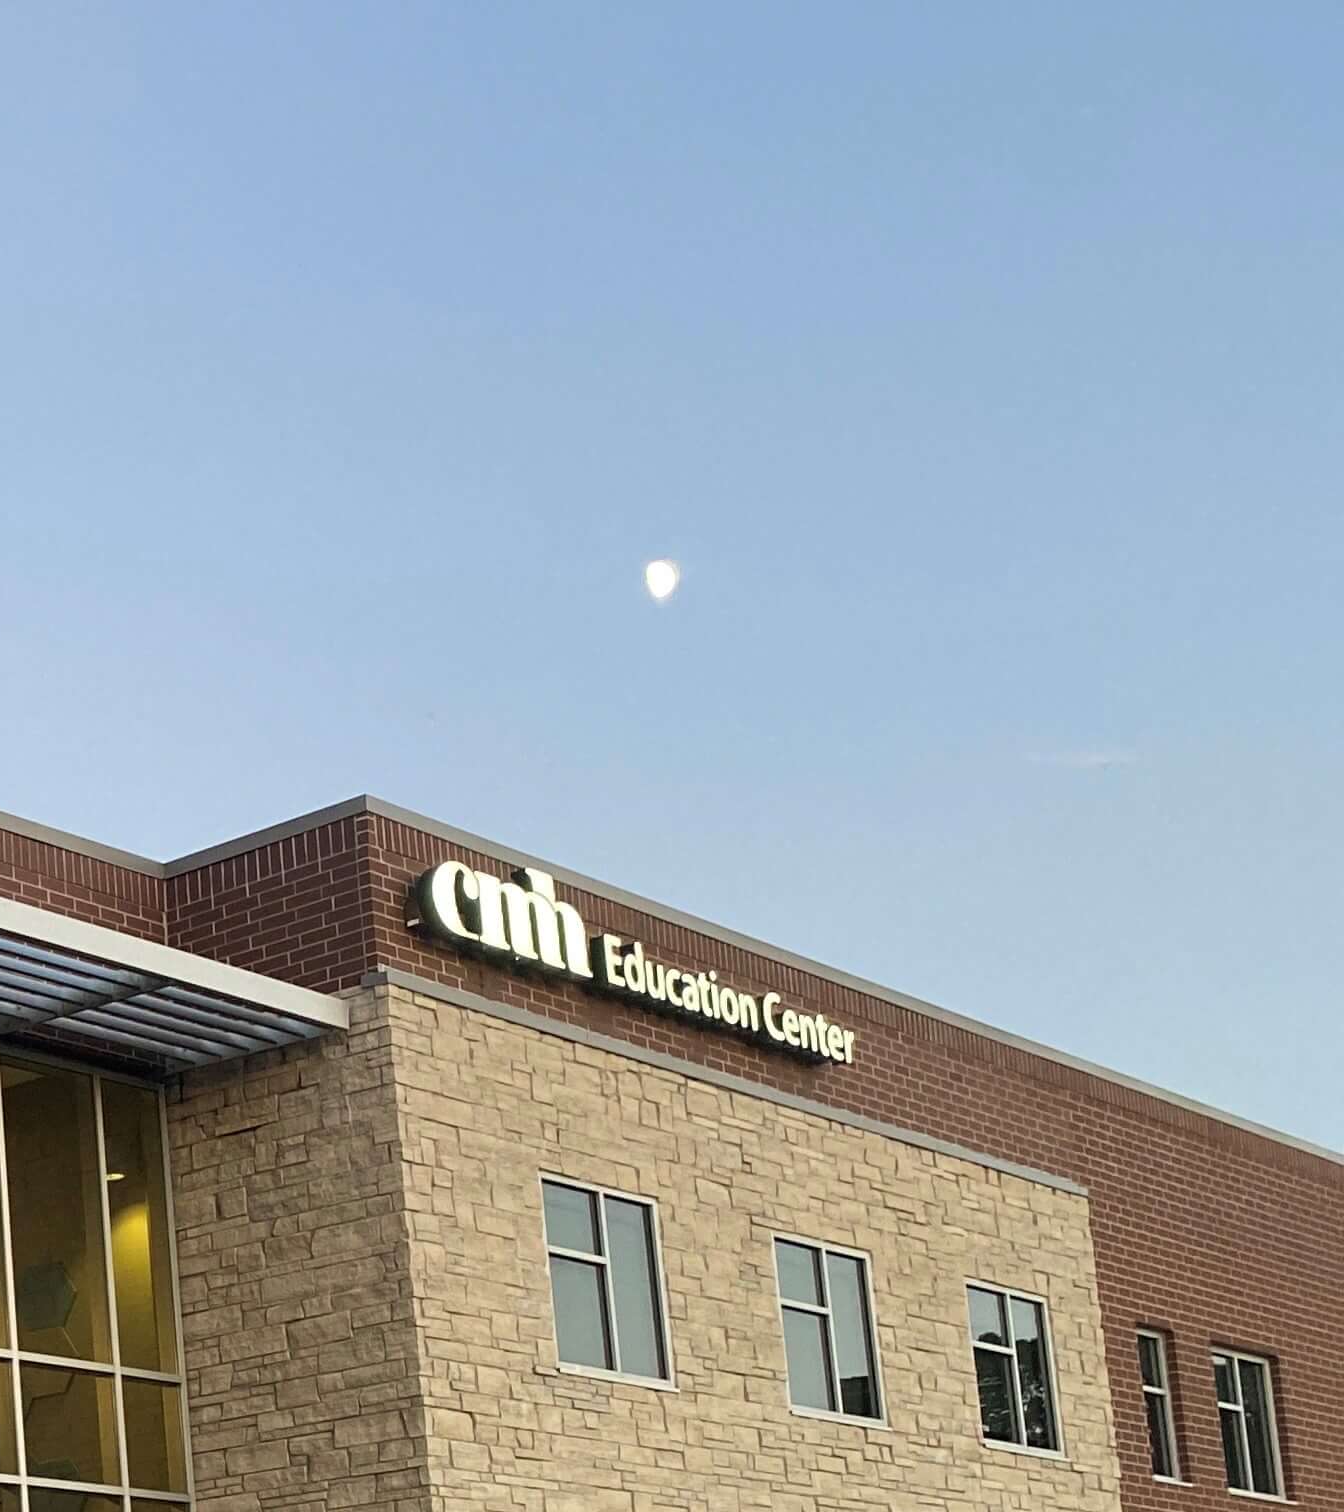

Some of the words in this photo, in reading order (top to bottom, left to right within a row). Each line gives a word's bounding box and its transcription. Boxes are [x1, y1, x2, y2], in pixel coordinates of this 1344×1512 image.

[431, 861, 593, 978] cmh
[603, 934, 758, 1032] Education
[763, 993, 854, 1064] Center
